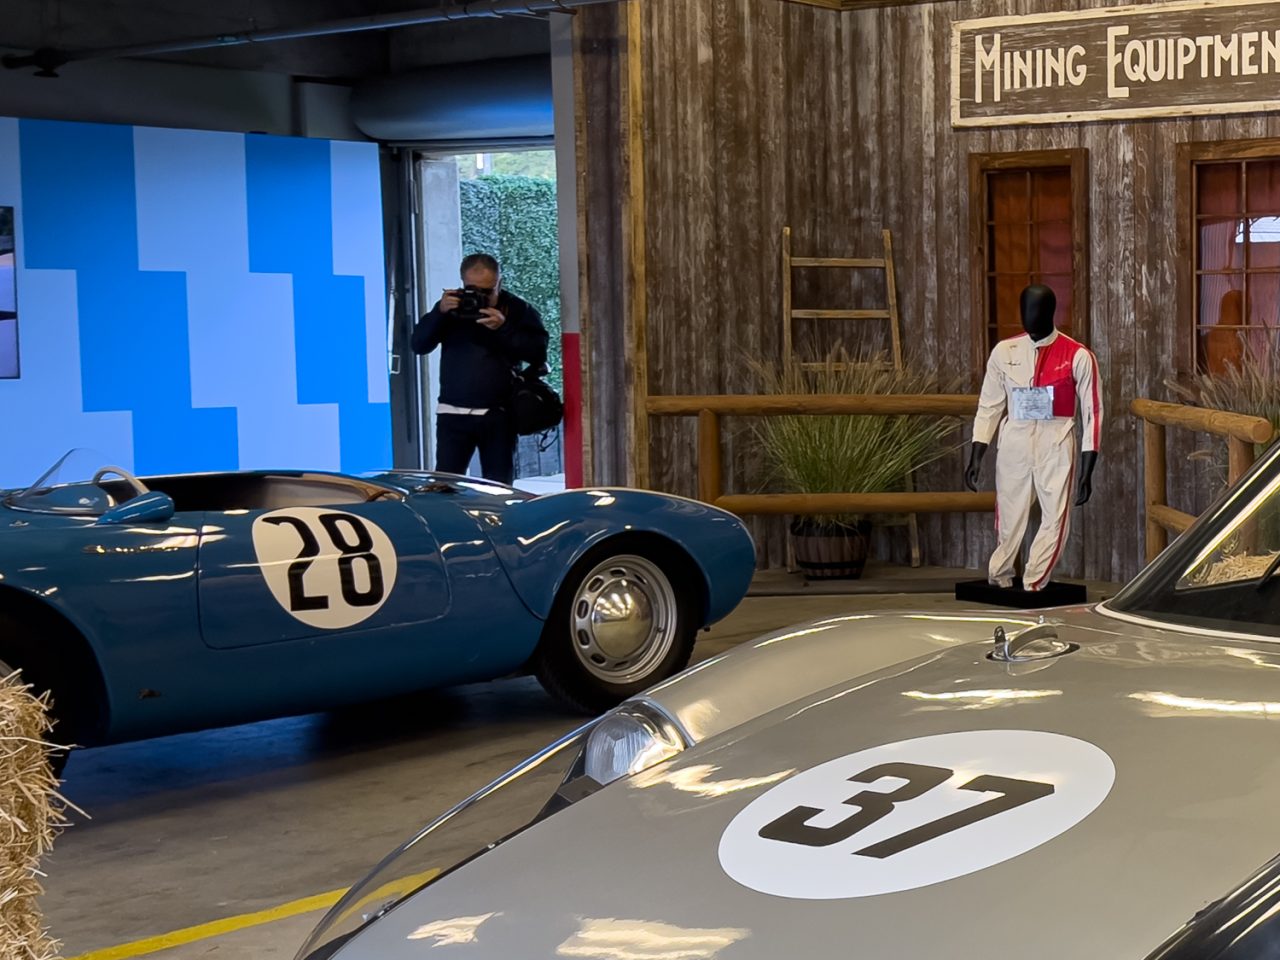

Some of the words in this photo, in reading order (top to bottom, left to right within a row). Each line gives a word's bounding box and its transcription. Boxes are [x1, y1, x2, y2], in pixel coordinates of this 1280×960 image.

[974, 33, 1087, 103] MINING
[262, 513, 384, 612] 28
[758, 762, 1055, 859] 37
